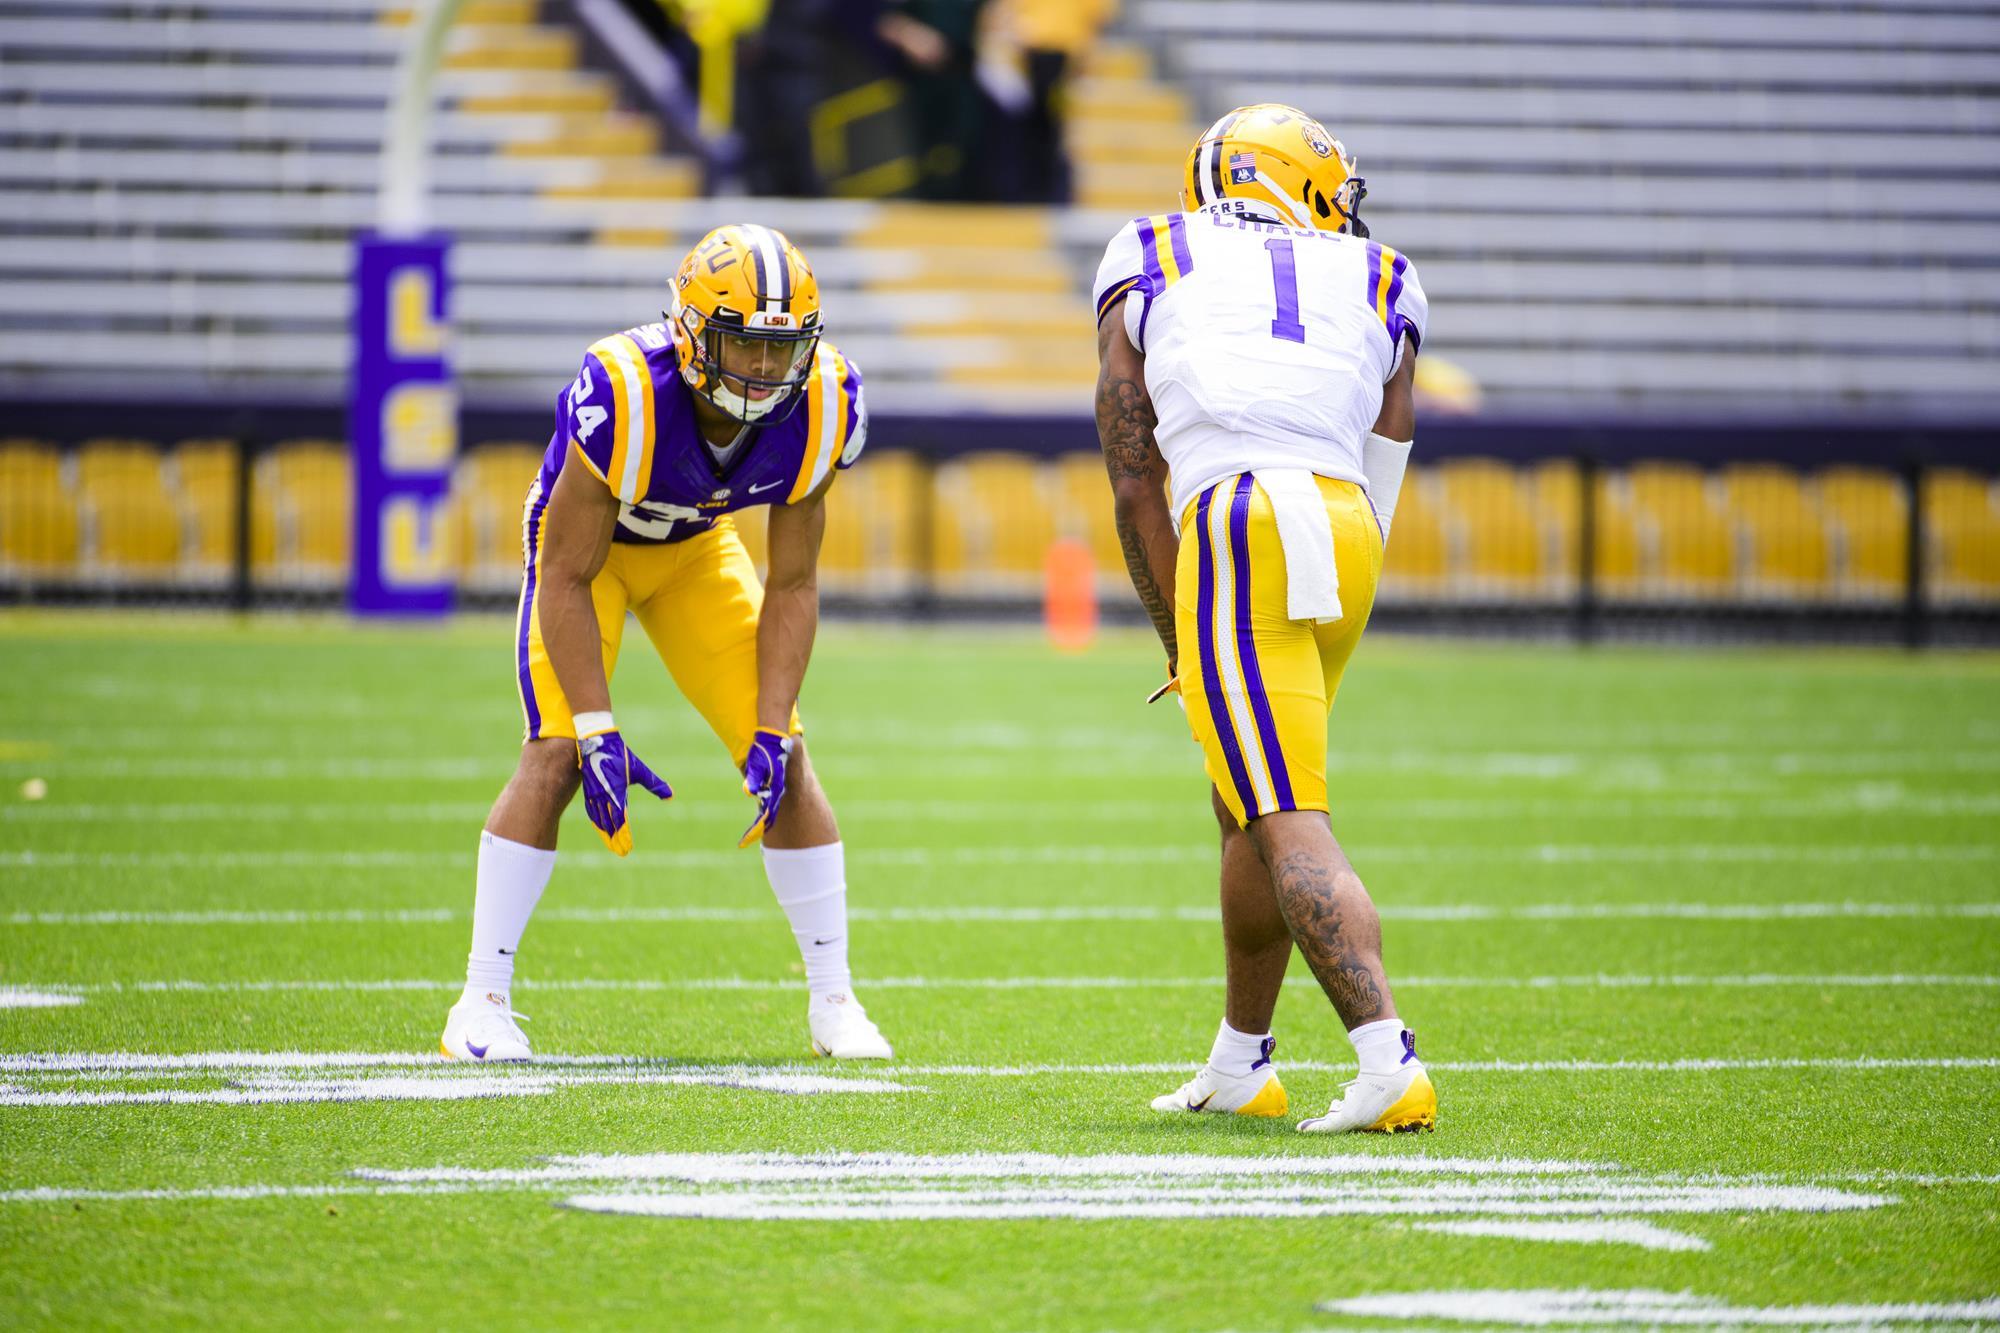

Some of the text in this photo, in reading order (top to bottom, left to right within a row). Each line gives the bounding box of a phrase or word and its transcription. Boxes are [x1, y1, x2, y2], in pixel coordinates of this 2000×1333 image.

[764, 316, 789, 326] LSU
[1264, 238, 1305, 344] 1
[384, 267, 456, 586] LSU
[567, 366, 608, 445] 24
